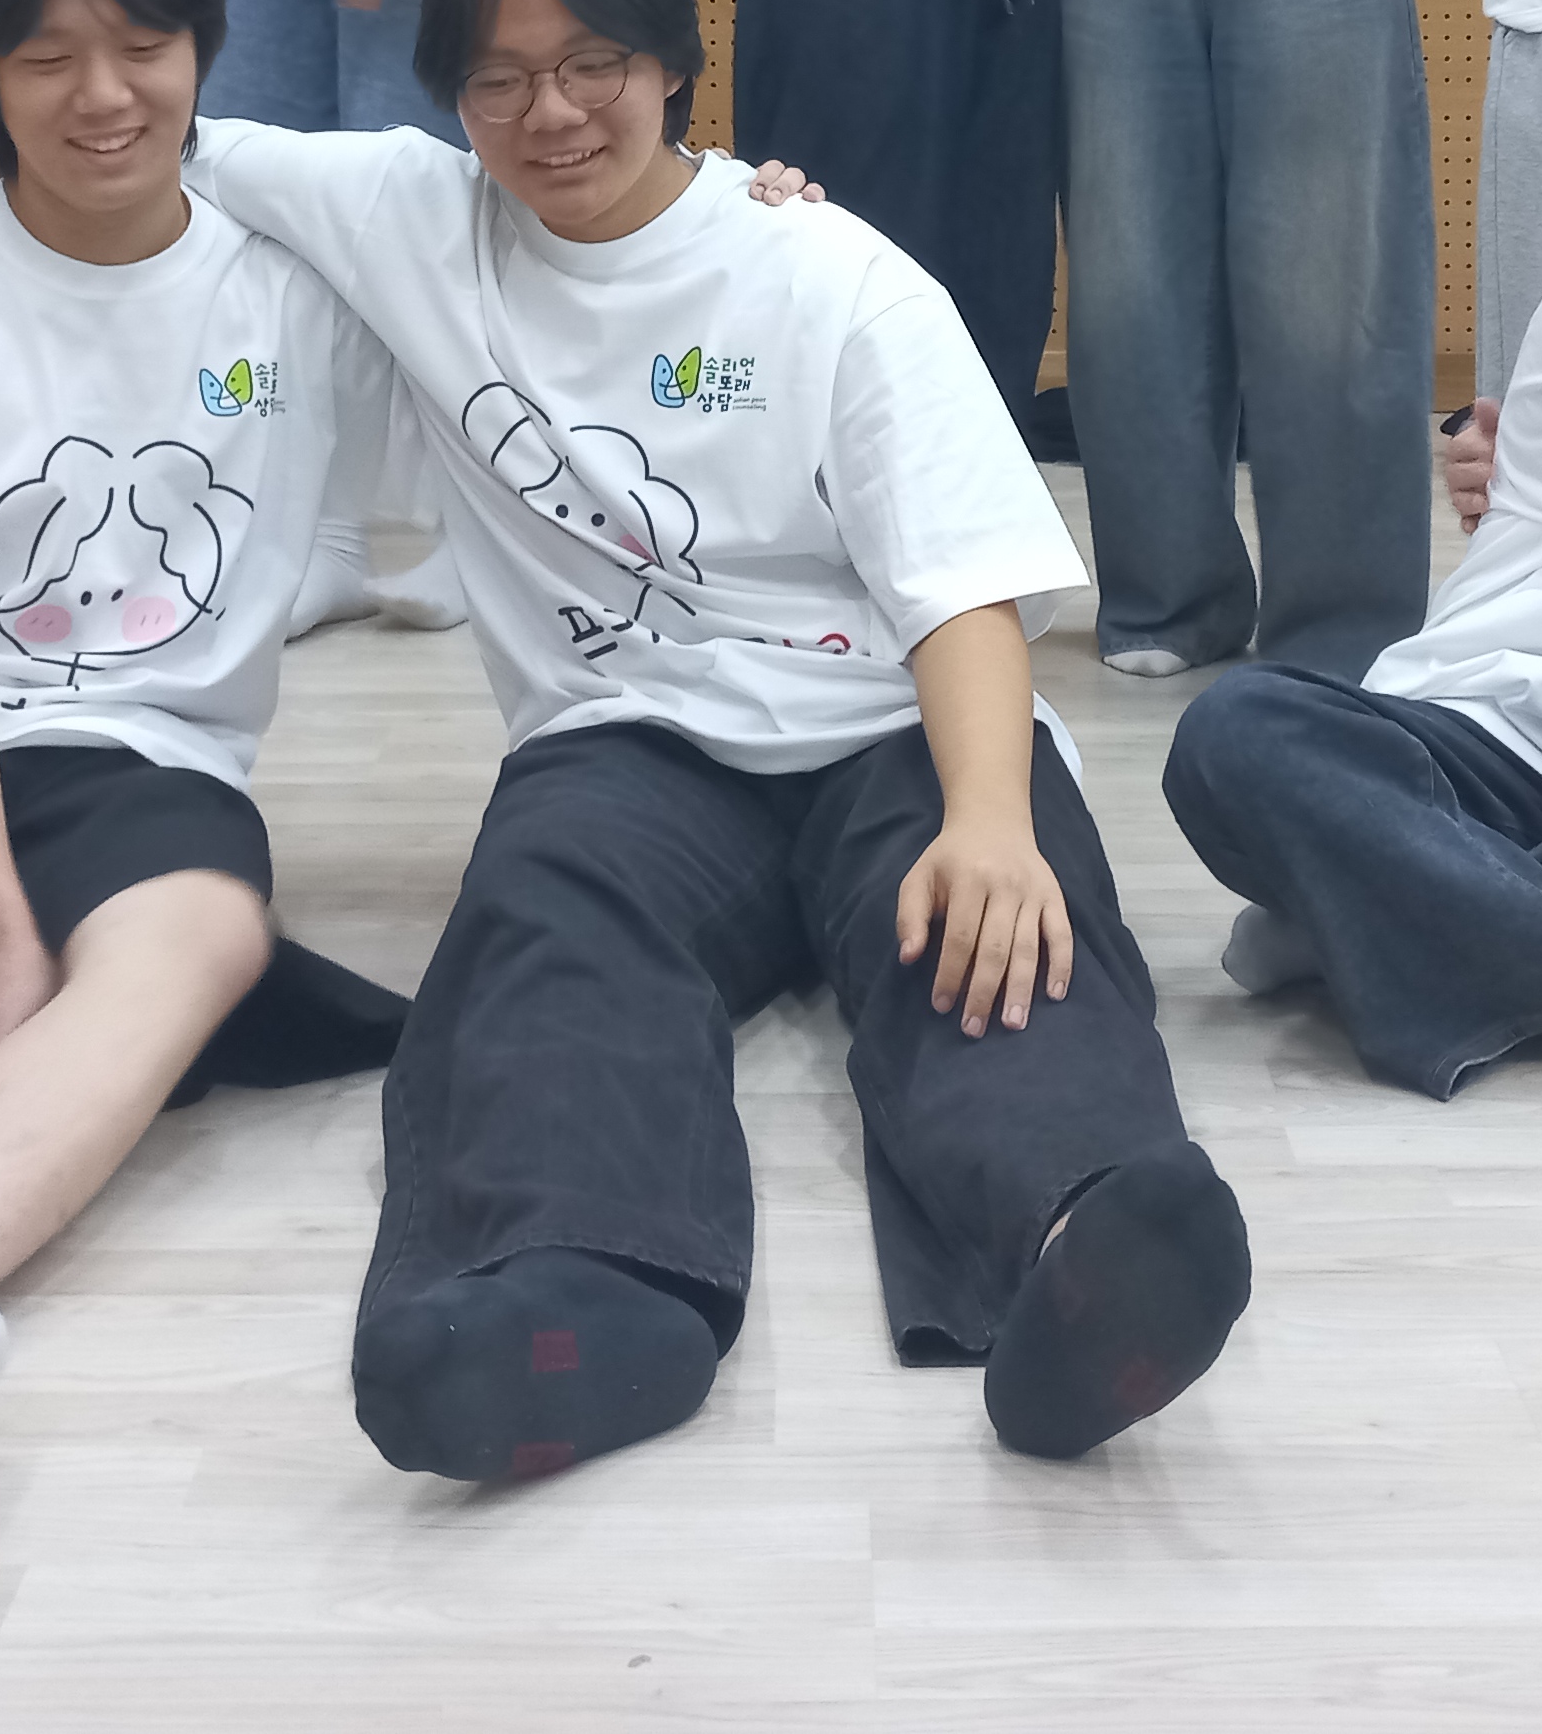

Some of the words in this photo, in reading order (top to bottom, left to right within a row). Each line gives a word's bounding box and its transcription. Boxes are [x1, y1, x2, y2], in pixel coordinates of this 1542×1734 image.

[702, 356, 756, 385] 솔리언
[717, 375, 752, 392] 또래
[696, 392, 733, 414] 상담
